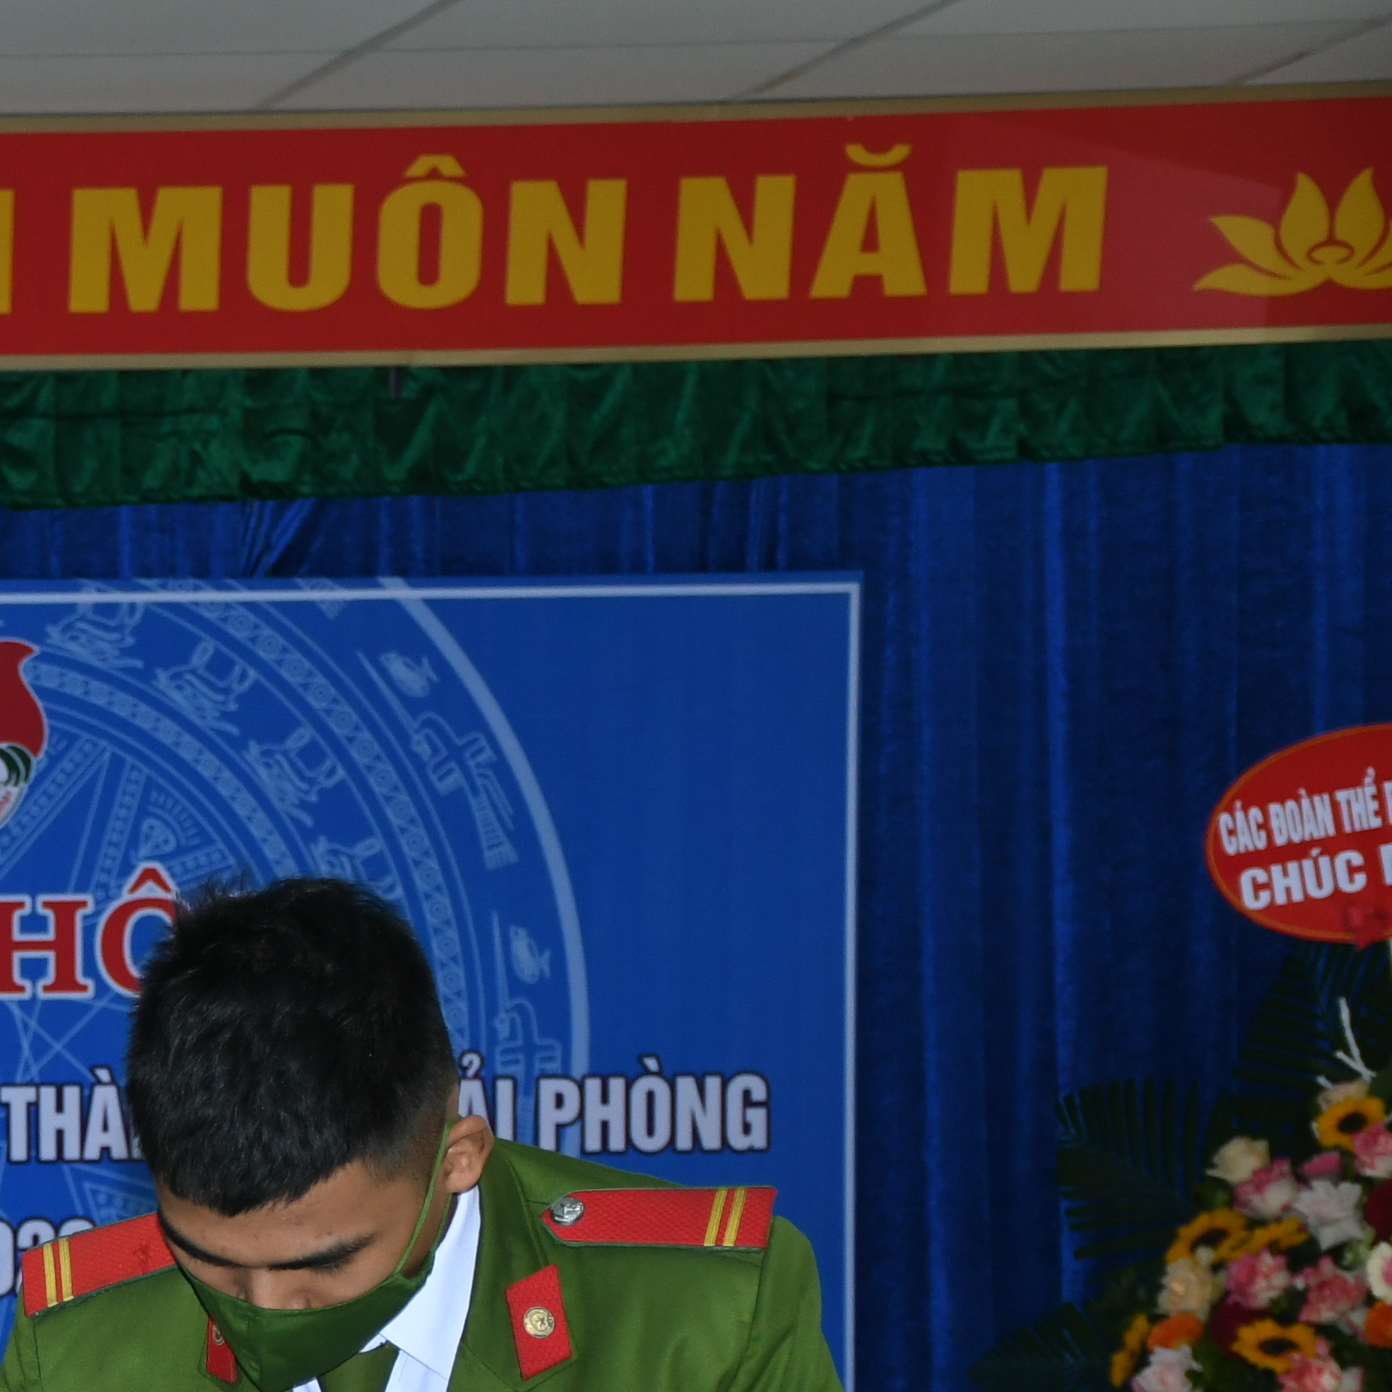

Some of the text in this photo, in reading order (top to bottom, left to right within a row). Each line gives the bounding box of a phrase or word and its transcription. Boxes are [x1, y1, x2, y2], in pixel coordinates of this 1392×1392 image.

[67, 153, 627, 312] MUÔN
[673, 143, 1109, 303] NĂM
[1219, 799, 1267, 856] CÁC
[1267, 787, 1336, 847] ĐOÀN
[1335, 766, 1382, 834] THỂ
[1239, 847, 1367, 911] CHÚC
[458, 1050, 515, 1142] ẢI
[537, 1054, 770, 1154] PHÒNG
